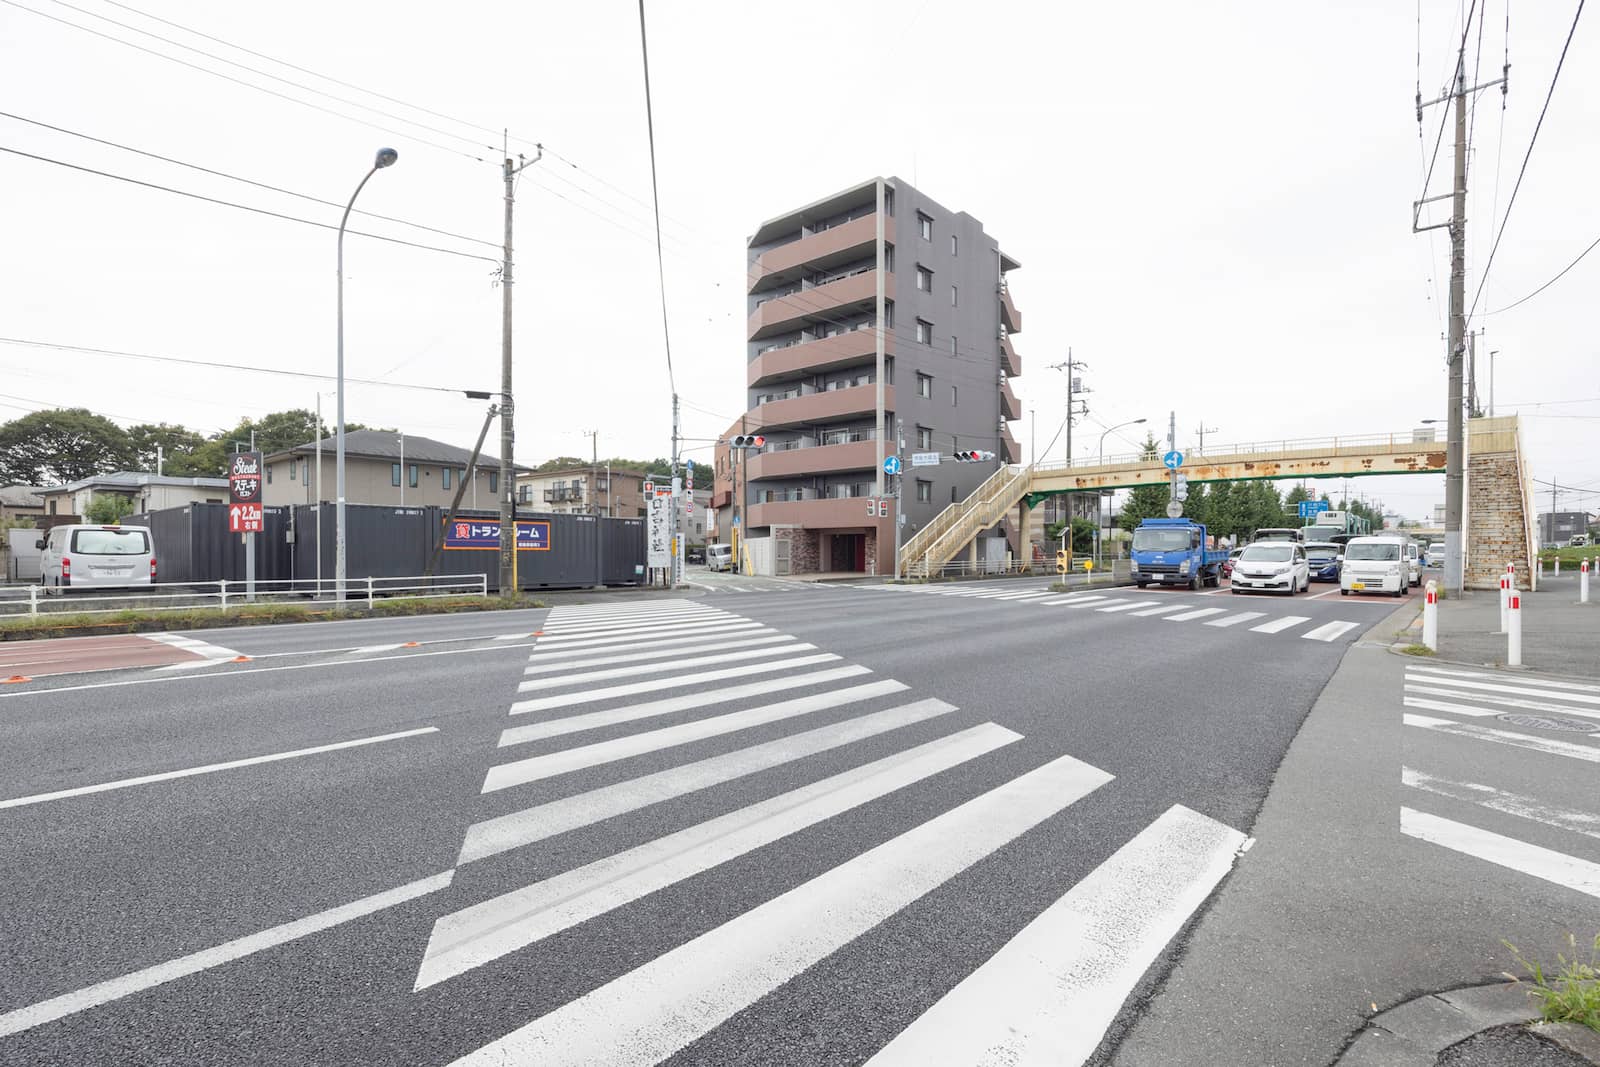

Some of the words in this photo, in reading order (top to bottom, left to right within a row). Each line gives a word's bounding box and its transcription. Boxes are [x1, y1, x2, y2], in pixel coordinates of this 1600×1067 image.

[233, 457, 257, 475] Steak
[234, 480, 257, 491] ステーキ
[242, 506, 261, 520] 2.2km
